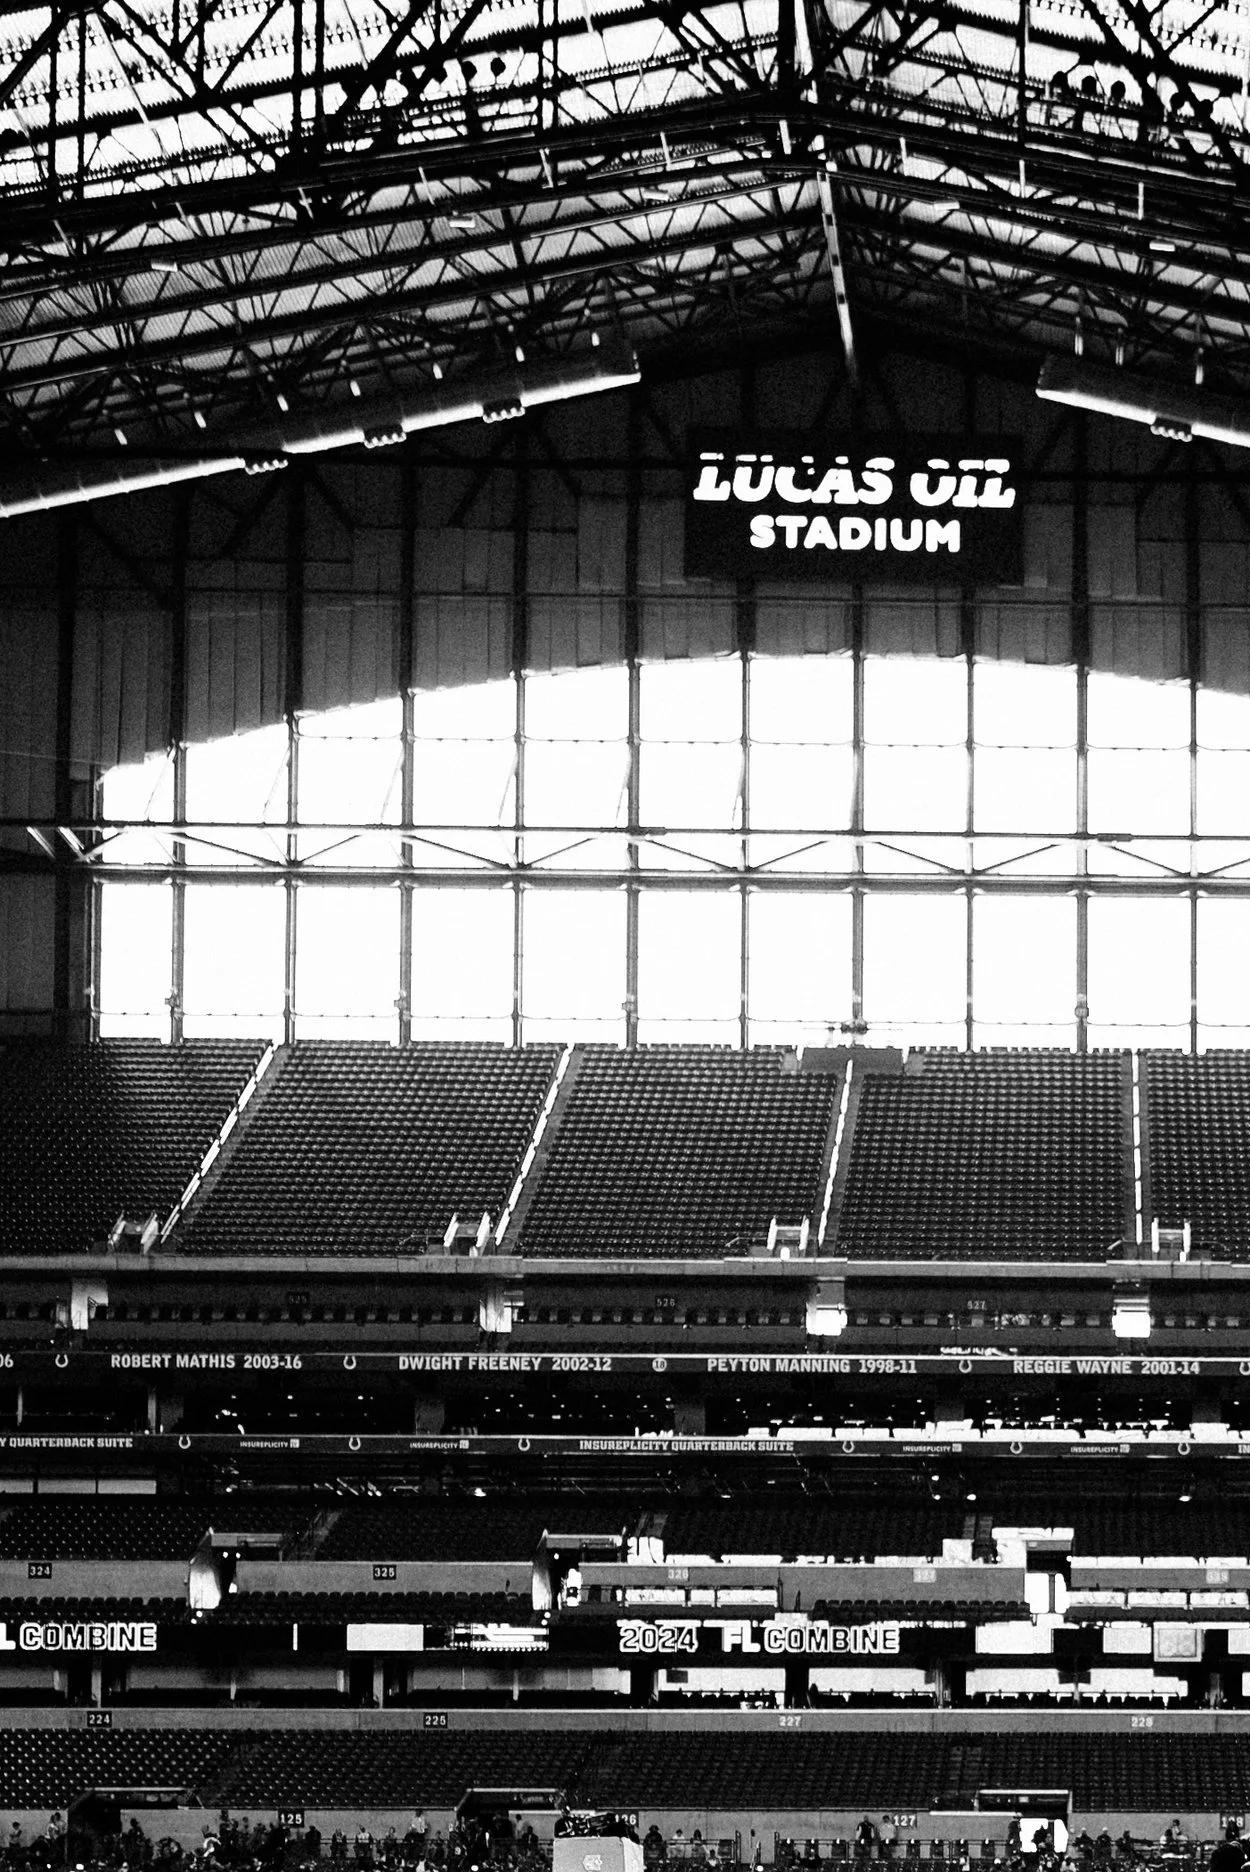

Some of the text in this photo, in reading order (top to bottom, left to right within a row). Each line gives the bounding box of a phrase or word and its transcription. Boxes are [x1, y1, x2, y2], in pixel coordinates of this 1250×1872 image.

[693, 452, 1016, 508] LUCAS OIL
[750, 515, 960, 552] STADIUM
[111, 1354, 303, 1370] ROBERT MATHIS 2003-16
[398, 1356, 612, 1372] DWIGHT FREENEY 2002-12
[707, 1357, 917, 1375] PEYTON MANNING 1998-11
[1013, 1360, 1201, 1376] REGGIE WAYNE 2001-14
[9, 1437, 93, 1449] QUARTERBACK
[97, 1437, 134, 1449] SUITE
[240, 1440, 289, 1449] INSUREPLICITY
[579, 1440, 794, 1452] INSUREPLICITY QUARTERBACK SUITE
[30, 1565, 51, 1576] 324
[374, 1567, 396, 1577] 325
[19, 1622, 157, 1651] COMBINE
[619, 1626, 699, 1653] 2024
[764, 1626, 900, 1654] COMBINE
[89, 1714, 111, 1725] 224
[425, 1715, 446, 1726] 225
[779, 1716, 802, 1727] 227
[280, 1813, 302, 1824] 125
[894, 1815, 916, 1827] 127
